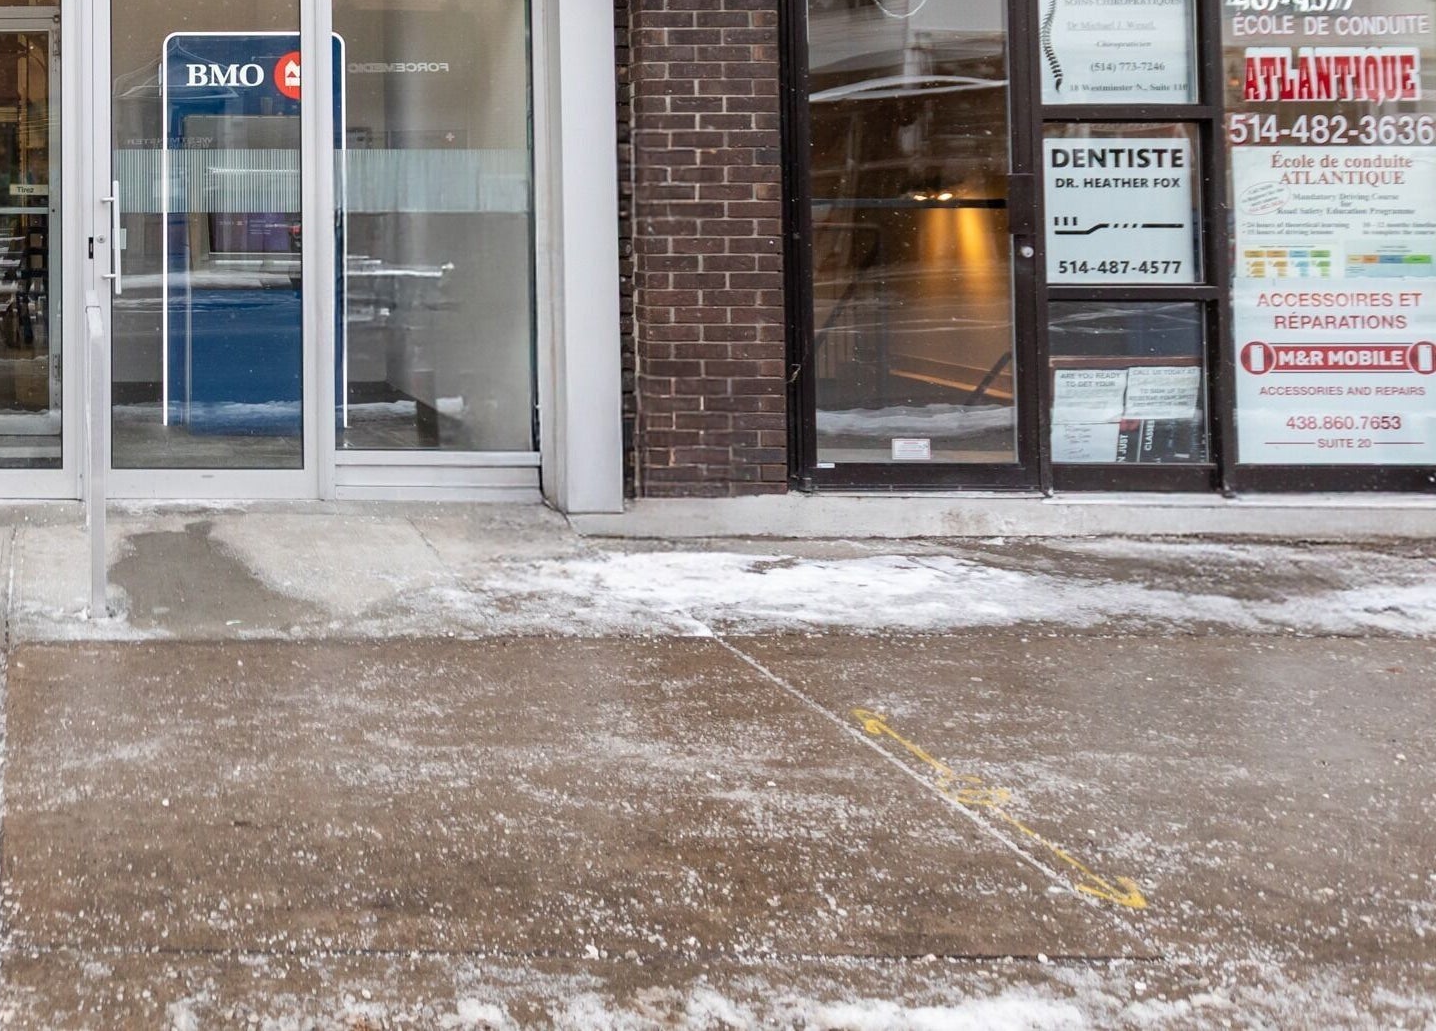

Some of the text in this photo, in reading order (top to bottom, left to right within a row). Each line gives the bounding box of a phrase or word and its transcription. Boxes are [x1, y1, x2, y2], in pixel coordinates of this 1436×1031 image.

[1232, 12, 1431, 36] ÉCOLE DE CONDUITE
[186, 63, 265, 87] BMO
[1090, 62, 1116, 73] (514)
[1244, 51, 1419, 105] ATLANTIQUE
[1230, 114, 1435, 144] 514-482-3636
[1051, 149, 1184, 168] DENTISTE
[1271, 151, 1413, 168] École de conduite
[1055, 178, 1181, 188] DR. HEATHER FOX
[1279, 171, 1405, 187] ATLANTIQUE
[1058, 261, 1182, 274] 514-487-4577
[1257, 293, 1423, 307] ACCESSOIRES ET
[1274, 312, 1407, 329] RÉPARATIONS
[1278, 350, 1404, 366] M&R MOBILE
[1259, 386, 1426, 395] ACCESSORIES AND REPAIRS
[1286, 416, 1402, 430] 438.860.7653
[1118, 434, 1129, 454] JUST
[1317, 438, 1372, 448] SUITE 20
